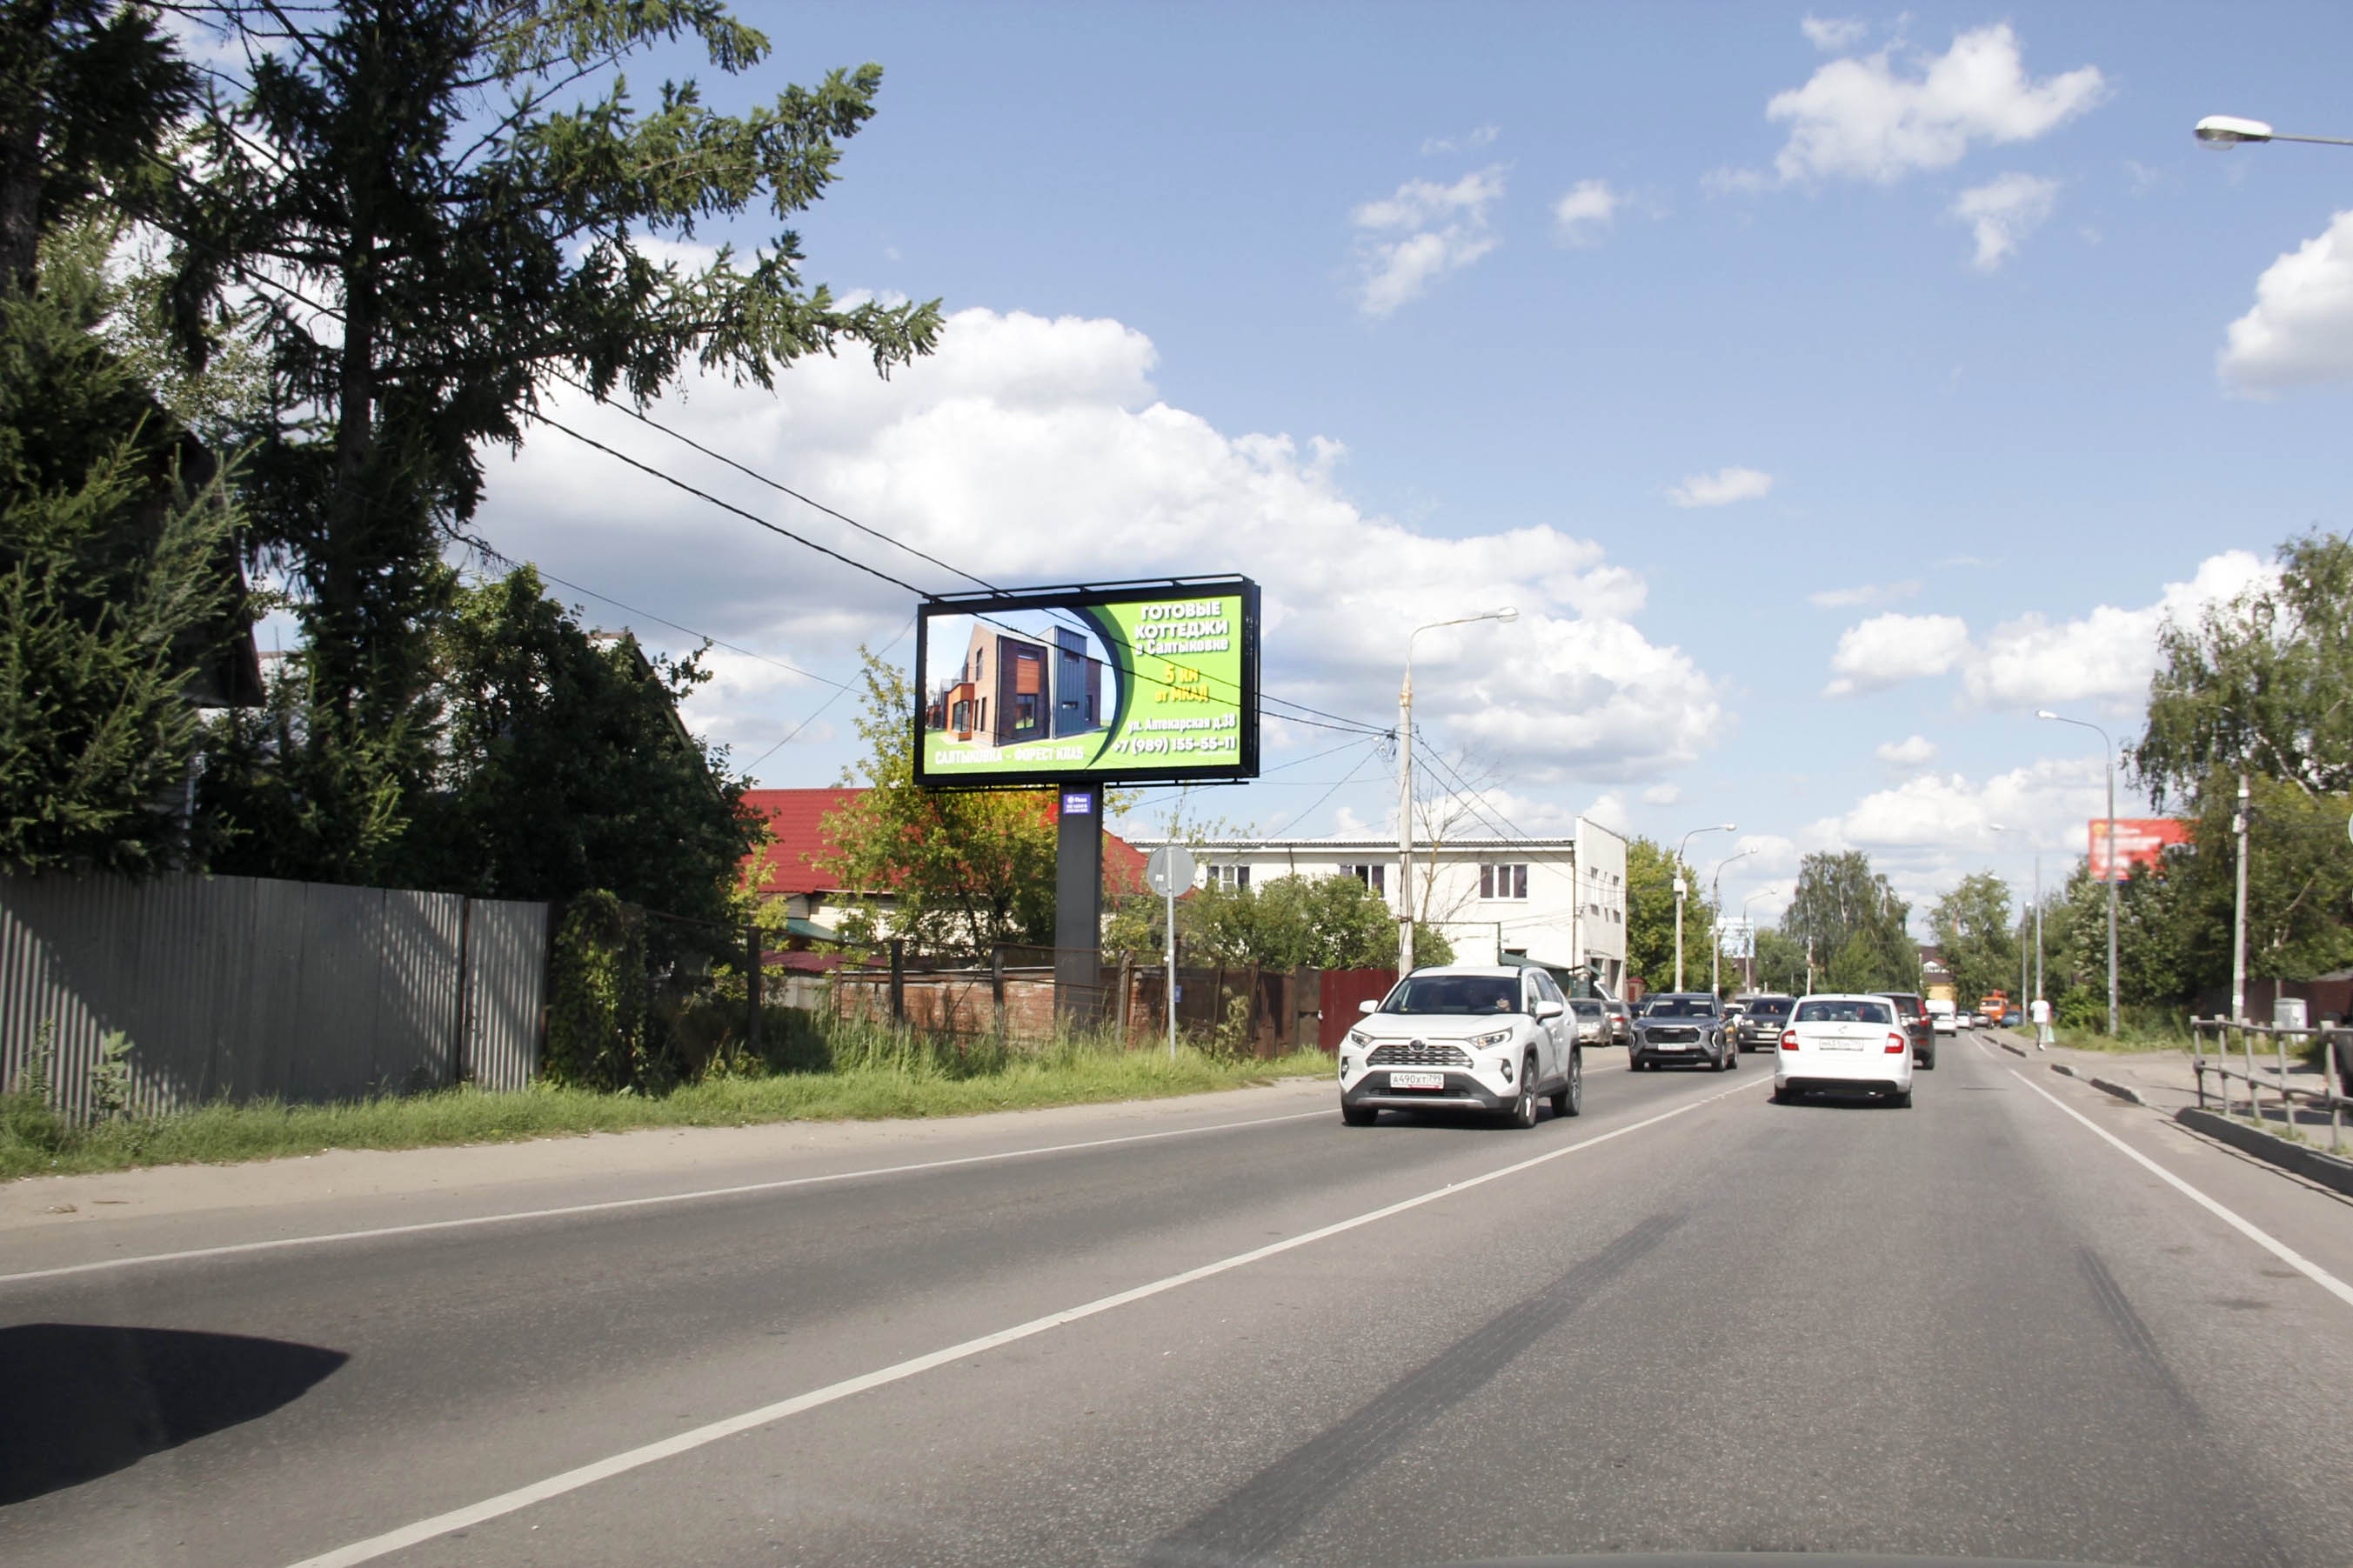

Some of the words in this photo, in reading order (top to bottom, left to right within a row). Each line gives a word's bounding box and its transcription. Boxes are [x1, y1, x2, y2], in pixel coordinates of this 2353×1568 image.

[1141, 601, 1221, 620] ГОТОВЫЕ
[1134, 619, 1228, 639] КОТТЕДЖИ
[1146, 638, 1229, 655] Салтыковке
[1166, 664, 1175, 684] 5
[1172, 684, 1208, 702] МКАД
[1129, 721, 1142, 734] ул.
[1146, 717, 1211, 732] Аптекарская
[1114, 741, 1129, 752] +7
[1132, 737, 1169, 754] (989)
[1173, 737, 1236, 751] 155-55-11
